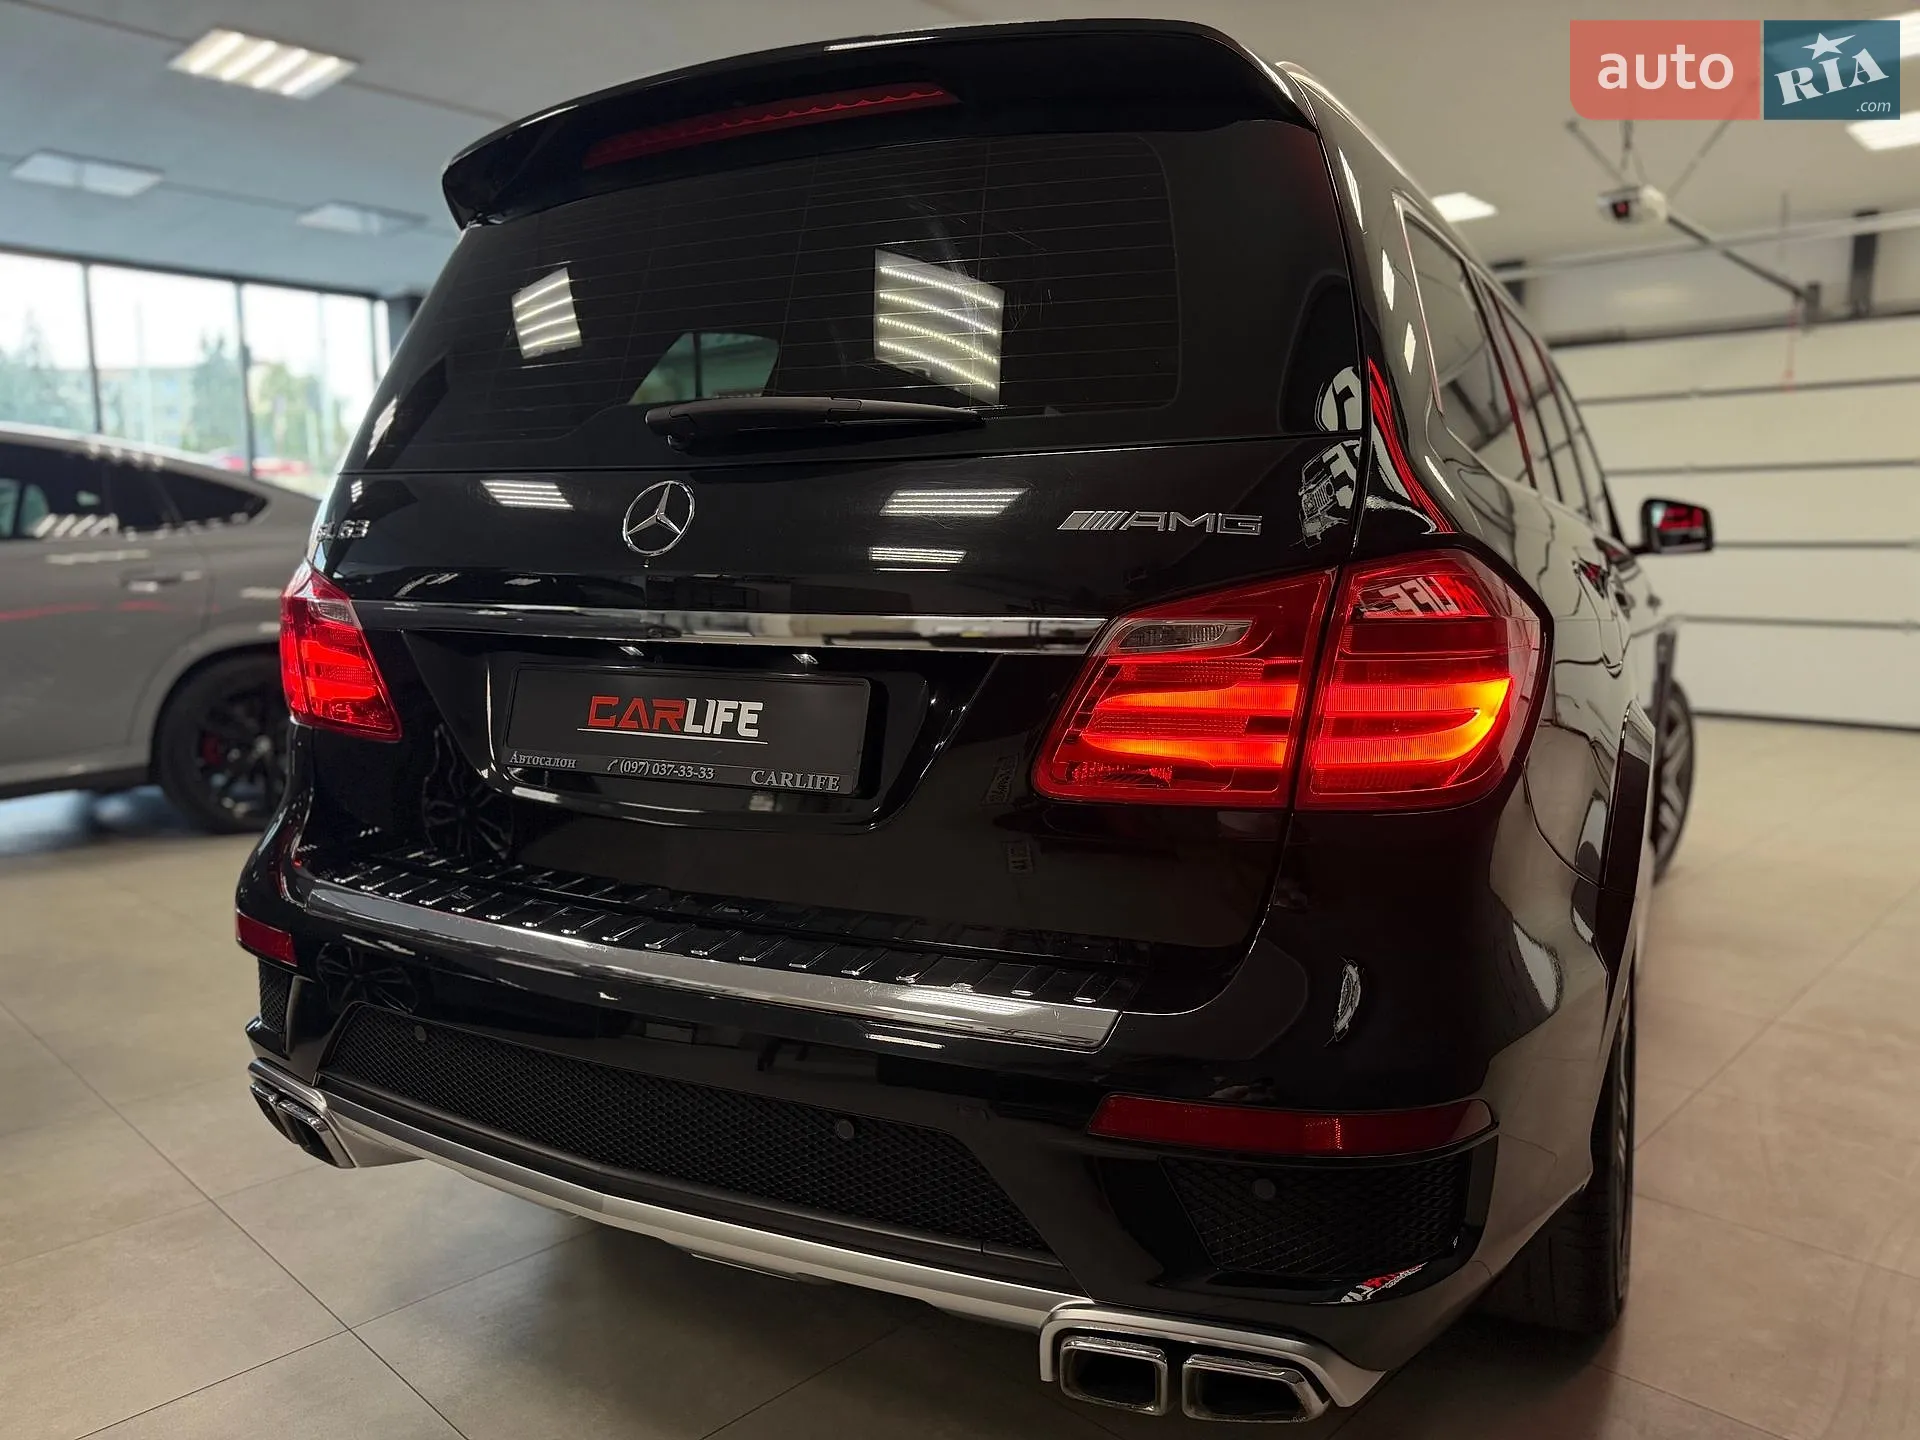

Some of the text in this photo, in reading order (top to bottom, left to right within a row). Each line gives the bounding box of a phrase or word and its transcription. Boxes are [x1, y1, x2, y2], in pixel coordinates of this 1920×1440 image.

[1119, 510, 1263, 536] AMG
[587, 695, 763, 738] CARLIFE
[509, 750, 577, 769] Автосалон
[620, 759, 715, 780] (097) 037-33-33
[751, 770, 840, 791] CARLIFE
